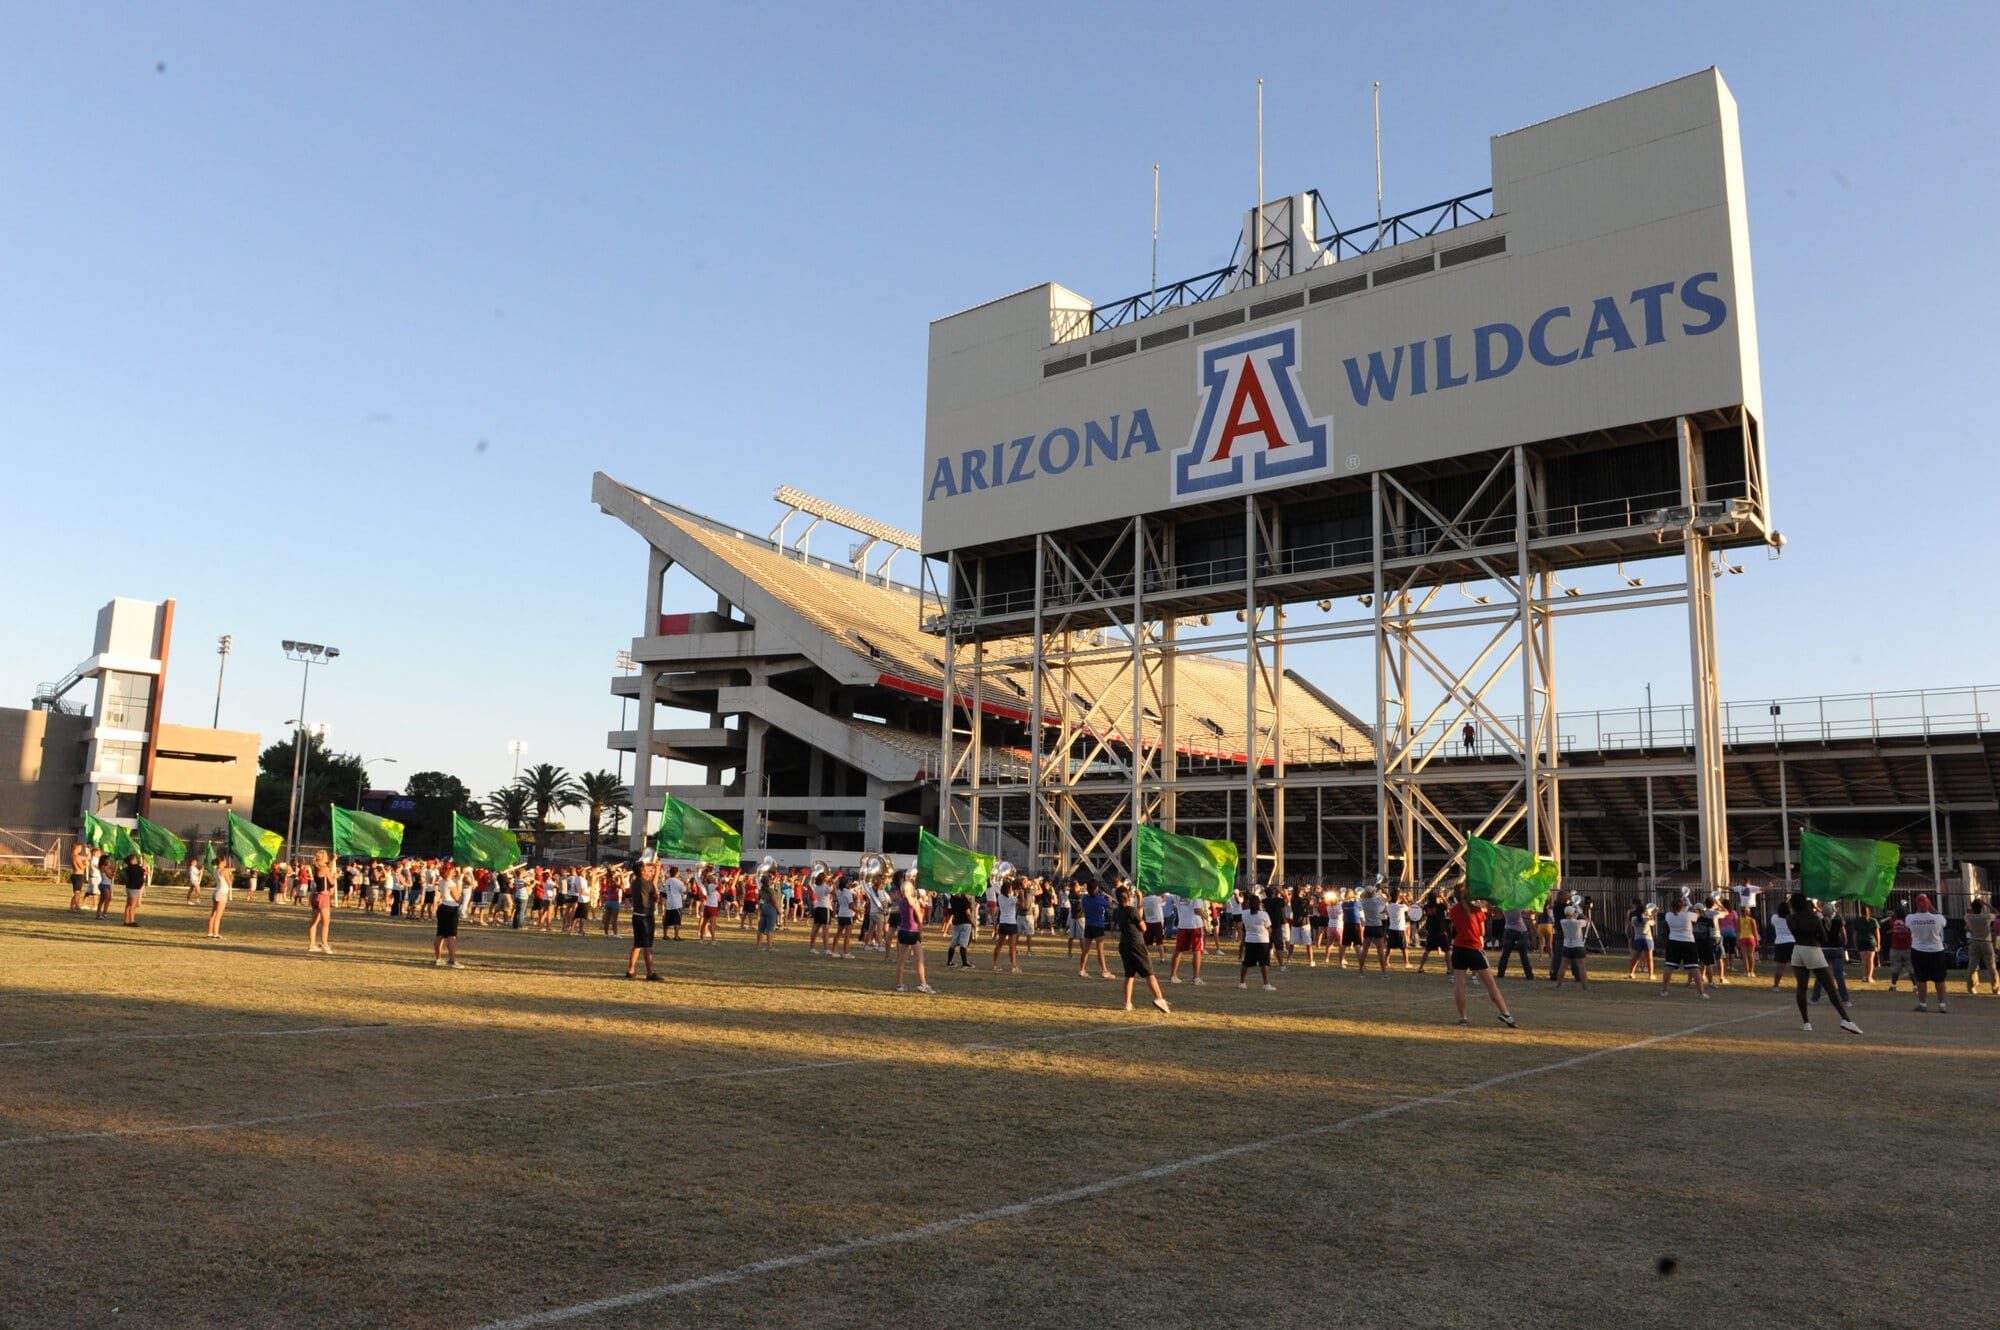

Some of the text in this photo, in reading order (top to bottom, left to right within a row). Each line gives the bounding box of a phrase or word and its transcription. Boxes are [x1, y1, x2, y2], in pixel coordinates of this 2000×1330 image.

[927, 272, 1727, 501] ARIZONA A WILDCATS
